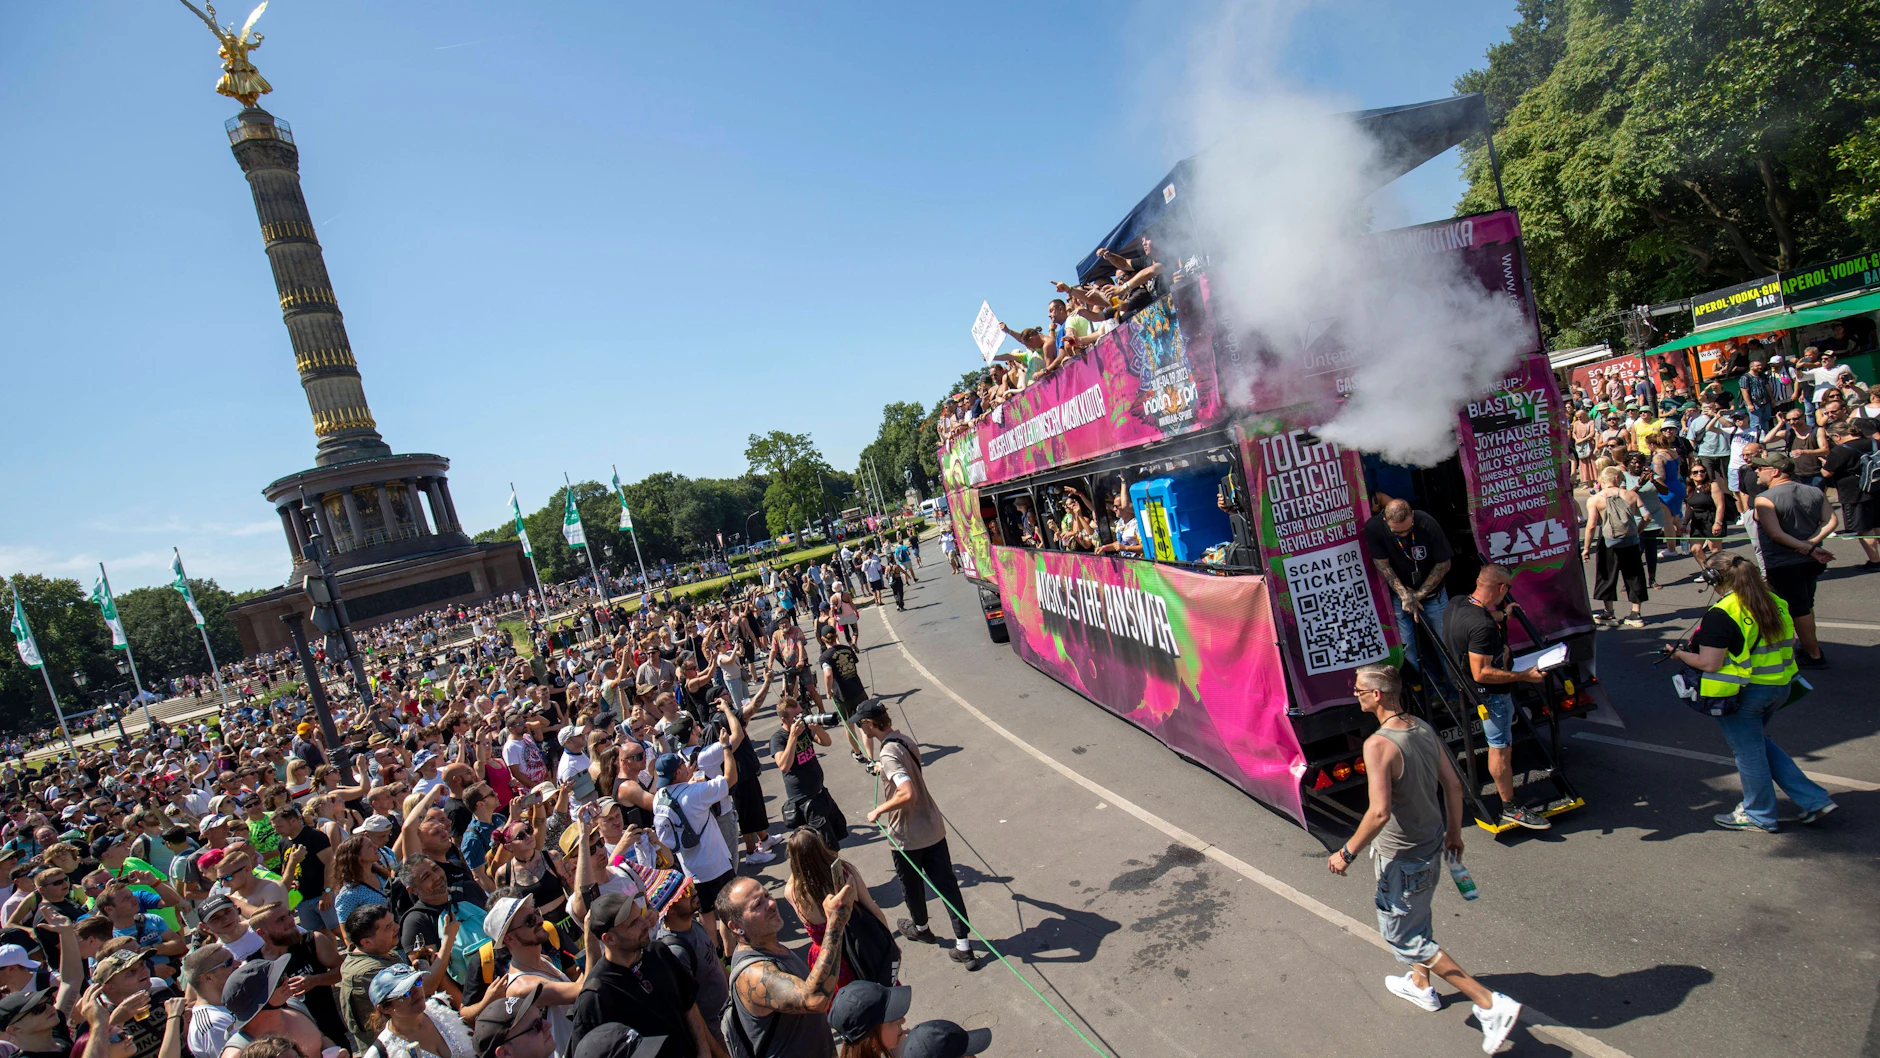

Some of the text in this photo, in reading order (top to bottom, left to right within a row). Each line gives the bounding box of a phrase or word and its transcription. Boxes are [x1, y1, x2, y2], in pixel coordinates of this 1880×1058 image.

[1755, 294, 1776, 308] BAR
[1503, 377, 1523, 389] UP:
[1467, 388, 1548, 418] BLASTOYZ
[1474, 422, 1551, 452] JOYHAUSER
[1477, 436, 1551, 462] KLAUDIA GAWLAS
[1478, 446, 1552, 474] MILO SPYKERS
[1480, 458, 1554, 483] VANESSA SUKOWSKI
[1266, 459, 1348, 503] OFFICIAL
[1481, 468, 1557, 497] DANIEL BOON
[1482, 480, 1559, 507] BASSTRONAUTEN
[1271, 485, 1350, 524] AFTERSHOW
[1494, 503, 1515, 518] AND
[1275, 506, 1355, 538] ASTRA KULTURHAUS
[1279, 520, 1357, 554] REVALER STR. 99
[1289, 550, 1359, 577] SCAN FOR
[1522, 543, 1572, 562] PLANET
[1290, 563, 1363, 593] TICKETS
[1035, 569, 1181, 656] MUSIC IS THE ANSWER
